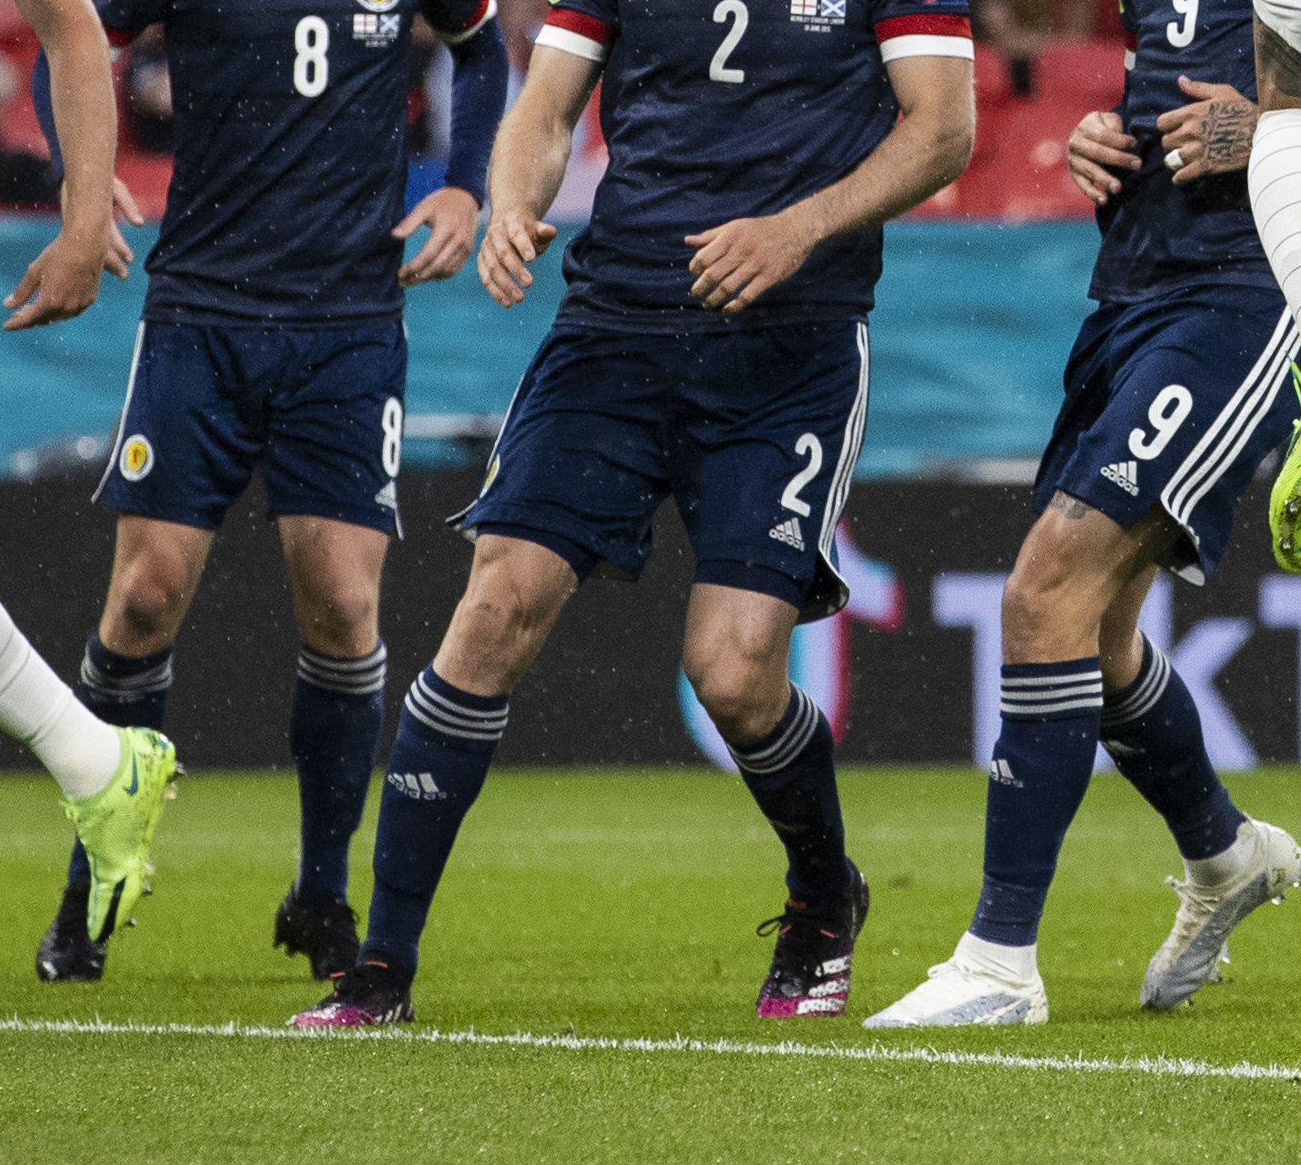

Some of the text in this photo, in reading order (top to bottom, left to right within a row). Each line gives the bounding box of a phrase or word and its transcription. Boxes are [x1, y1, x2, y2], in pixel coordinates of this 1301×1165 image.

[293, 15, 329, 97] 8
[381, 396, 403, 478] 8
[1128, 384, 1193, 460] 9
[781, 432, 823, 517] 2
[1100, 466, 1139, 496] adidas
[768, 528, 805, 552] adidas
